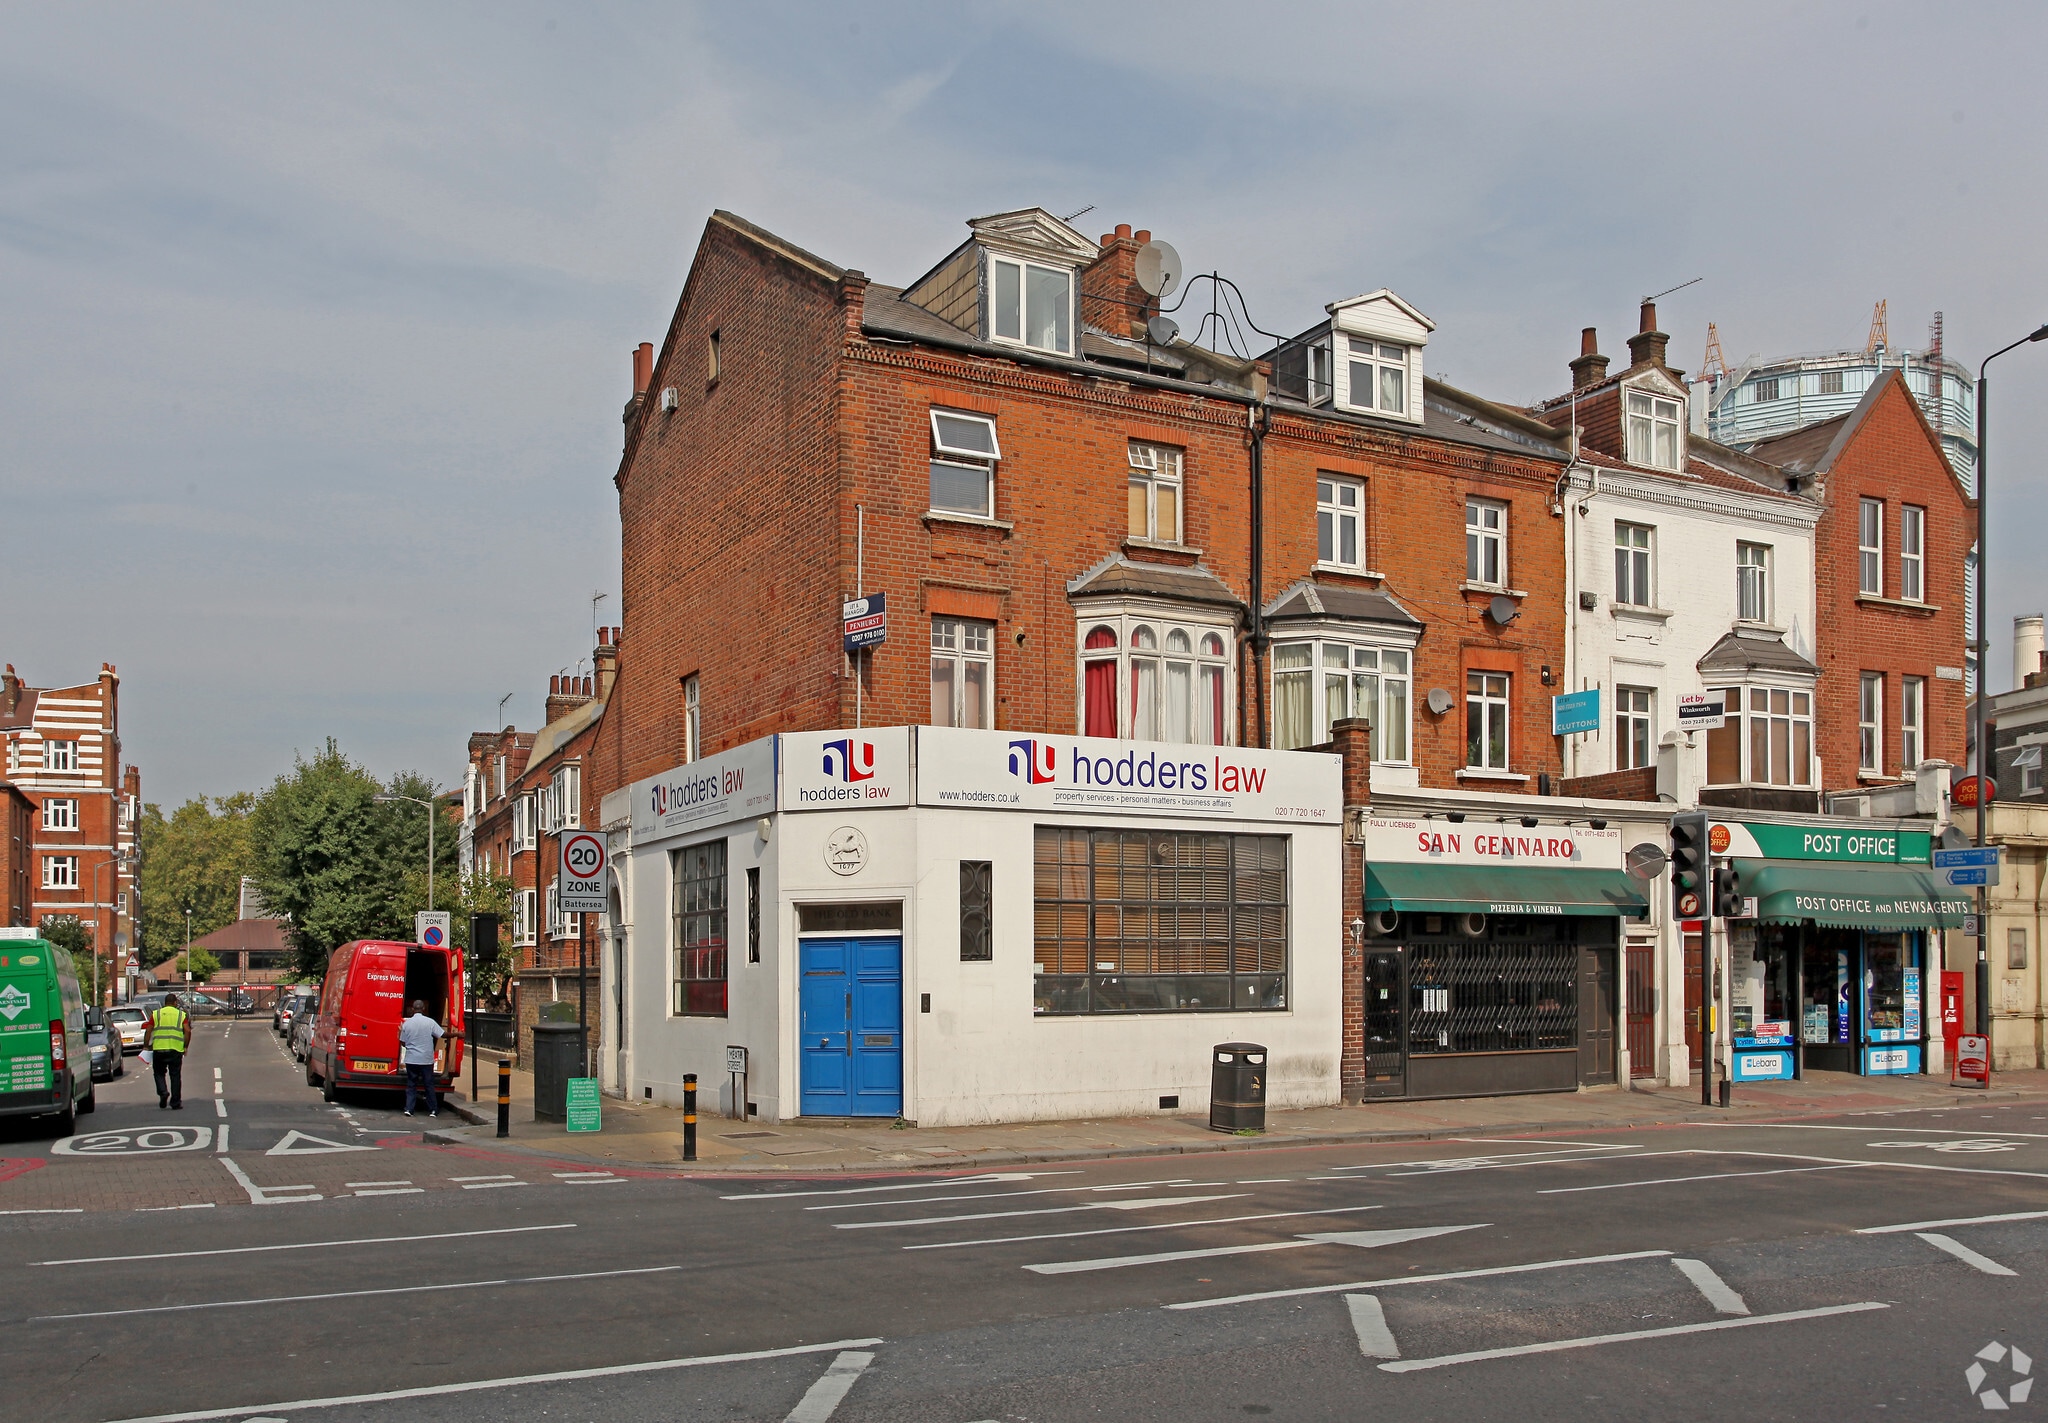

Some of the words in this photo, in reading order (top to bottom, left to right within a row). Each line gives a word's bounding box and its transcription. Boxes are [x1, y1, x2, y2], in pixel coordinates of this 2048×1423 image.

[850, 617, 880, 631] PENHURST
[1681, 696, 1693, 704] Let
[1695, 695, 1705, 704] by
[1557, 719, 1598, 731] CLUTTONS
[1334, 757, 1342, 765] 24
[1073, 746, 1208, 791] hodders
[1214, 755, 1267, 793] law
[670, 774, 718, 811] hodders
[722, 765, 745, 796] law
[800, 785, 860, 801] hodders
[865, 784, 891, 799] law
[939, 790, 1021, 804] www.hodders.co.uk
[1055, 792, 1085, 803] property
[1086, 794, 1115, 803] services
[1120, 794, 1151, 805] personal
[1151, 797, 1177, 806] matters
[1181, 798, 1212, 807] business
[1212, 799, 1233, 808] affairs
[1274, 806, 1288, 816] 020
[1289, 807, 1294, 816] 7
[1295, 807, 1308, 817] 720
[1310, 809, 1326, 818] 1647
[1370, 820, 1388, 828] FULLY
[1389, 821, 1417, 829] LICENSED
[1712, 830, 1726, 838] POST
[1418, 832, 1461, 854] SAN
[1474, 835, 1574, 858] GENNARO
[1804, 834, 1842, 853] POST
[1847, 836, 1896, 856] OFFICE
[571, 848, 597, 866] 20
[567, 881, 600, 892] ZONE
[564, 900, 602, 908] Battersea
[1490, 904, 1524, 913] PIZZERIA
[1525, 904, 1531, 913] &
[1533, 904, 1563, 914] VINERIA
[1795, 896, 1826, 911] POST
[1829, 898, 1872, 913] OFFICE
[1875, 904, 1892, 913] AND
[1894, 901, 1968, 914] NEWSAGENTS
[814, 909, 833, 920] THE
[836, 908, 859, 919] OLD
[862, 907, 892, 918] BANK
[367, 972, 389, 981] Express
[1754, 1037, 1768, 1045] Ticket
[1768, 1037, 1780, 1045] Stop
[1752, 1058, 1777, 1068] Lebara
[1880, 1054, 1903, 1063] Lebara
[78, 1131, 185, 1151] 20
